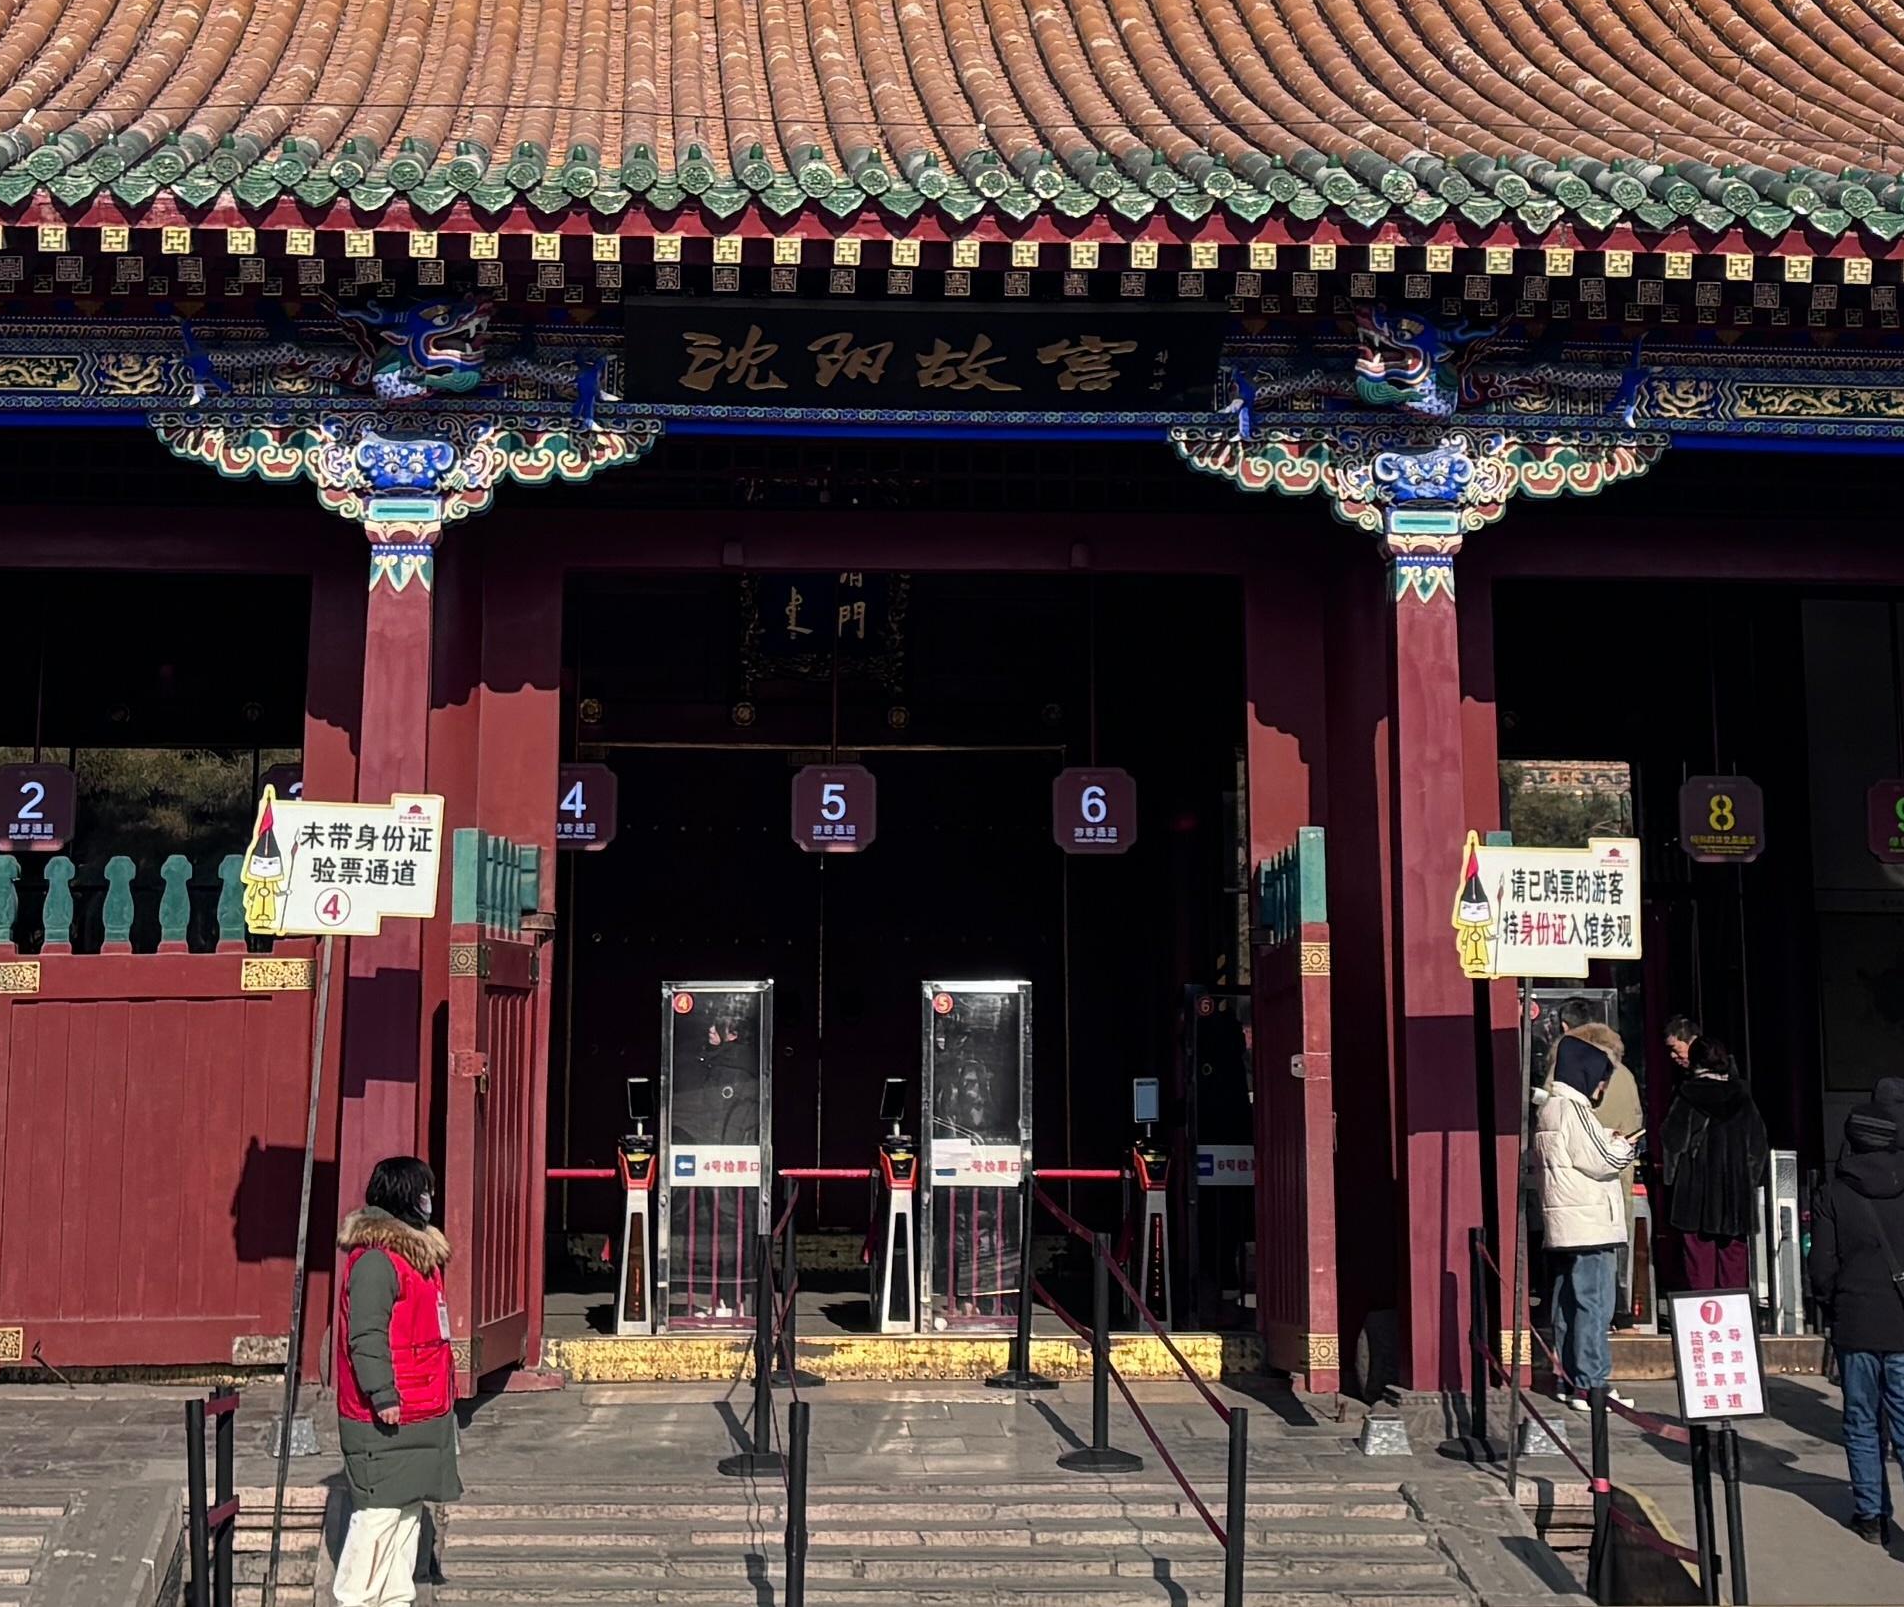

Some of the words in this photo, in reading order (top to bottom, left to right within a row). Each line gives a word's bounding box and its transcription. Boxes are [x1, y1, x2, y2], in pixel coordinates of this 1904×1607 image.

[679, 325, 1138, 391] 沈阳故宫
[18, 781, 45, 819] 2
[560, 781, 587, 819] 4
[820, 783, 846, 821] 5
[1081, 785, 1107, 823] 6
[1708, 794, 1735, 831] 8
[301, 822, 433, 852] 未带身份证
[311, 857, 417, 886] 验票通道
[1511, 868, 1624, 905] 请已购票的游客
[1503, 911, 1632, 947] 持身份证入馆参观
[703, 1160, 760, 1173] 4号检票口
[970, 1160, 1021, 1173] 号检票口
